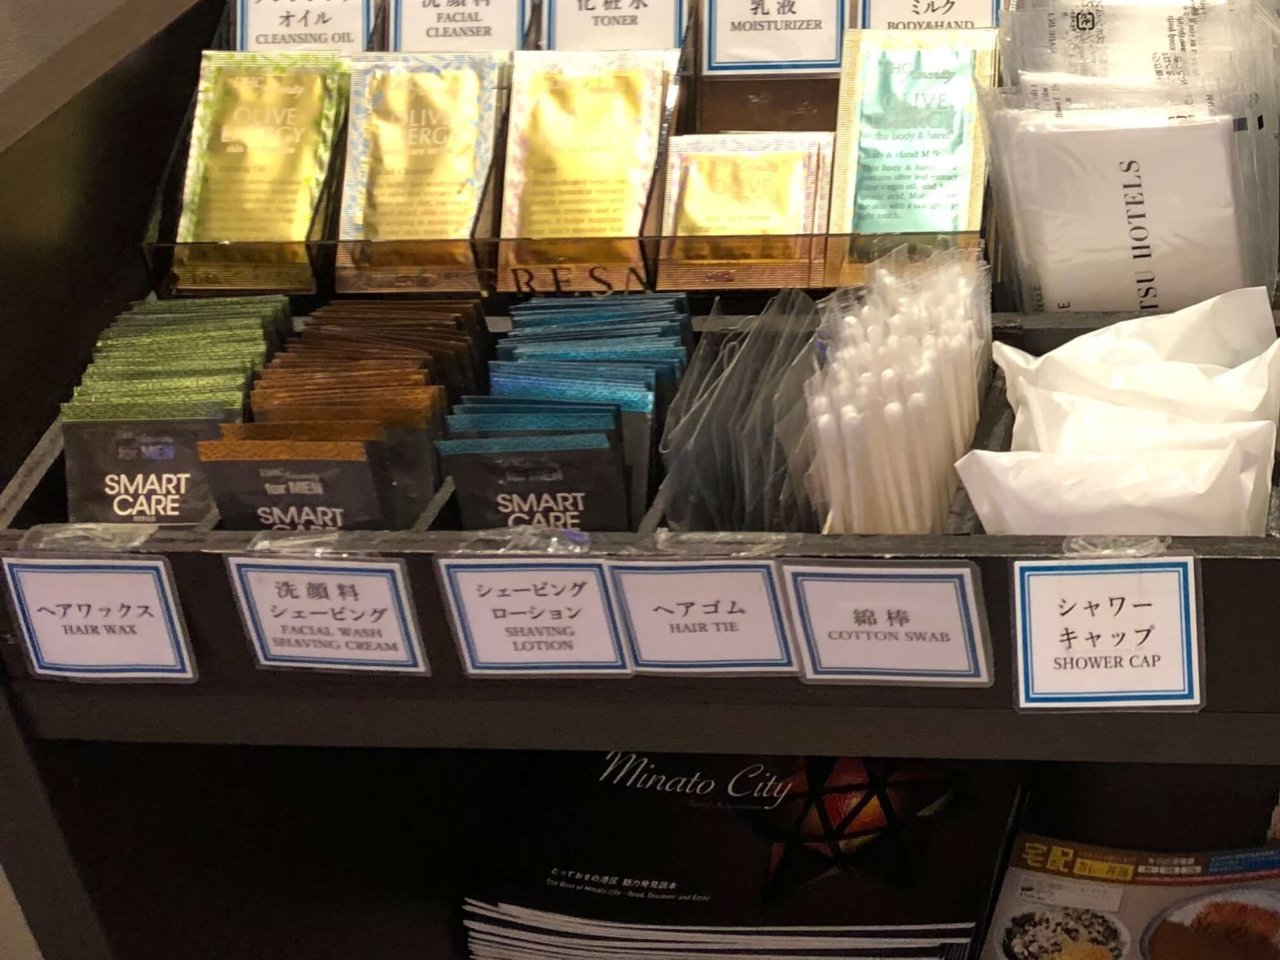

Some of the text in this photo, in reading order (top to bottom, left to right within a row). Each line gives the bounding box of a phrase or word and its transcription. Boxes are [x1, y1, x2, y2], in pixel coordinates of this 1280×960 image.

[278, 10, 332, 27] オイル
[436, 12, 483, 24] FACIAL
[592, 14, 639, 27] TONER
[729, 19, 823, 33] MOISTURIZER
[256, 33, 355, 44] CLEANSING OIL
[426, 26, 492, 38] CLEANSER
[1119, 159, 1152, 259] HOTELS
[104, 473, 191, 495] SMART
[113, 495, 180, 516] CARE
[496, 492, 586, 513] SMART
[257, 506, 344, 527] SMART
[275, 581, 360, 602] 洗顔料
[475, 581, 587, 601] シェービング
[36, 602, 155, 620] ヘアワックス
[270, 604, 388, 625] シェービング
[493, 605, 582, 622] ローション
[653, 599, 747, 618] ヘアゴム
[1057, 596, 1154, 618] シャワー
[852, 607, 912, 627] 綿棒
[62, 624, 138, 637] HAIR WAX
[279, 626, 384, 641] FACIAL WASH
[504, 627, 576, 640] SHAVING
[668, 621, 740, 635] HAIR TIE
[827, 628, 951, 644] COTTON SWAB
[1058, 624, 1156, 649] キャップ
[271, 638, 399, 653] SHAVING CREAM
[512, 640, 575, 653] LOTION
[1052, 653, 1162, 672] SHOWER CAP
[598, 751, 794, 810] Minato City
